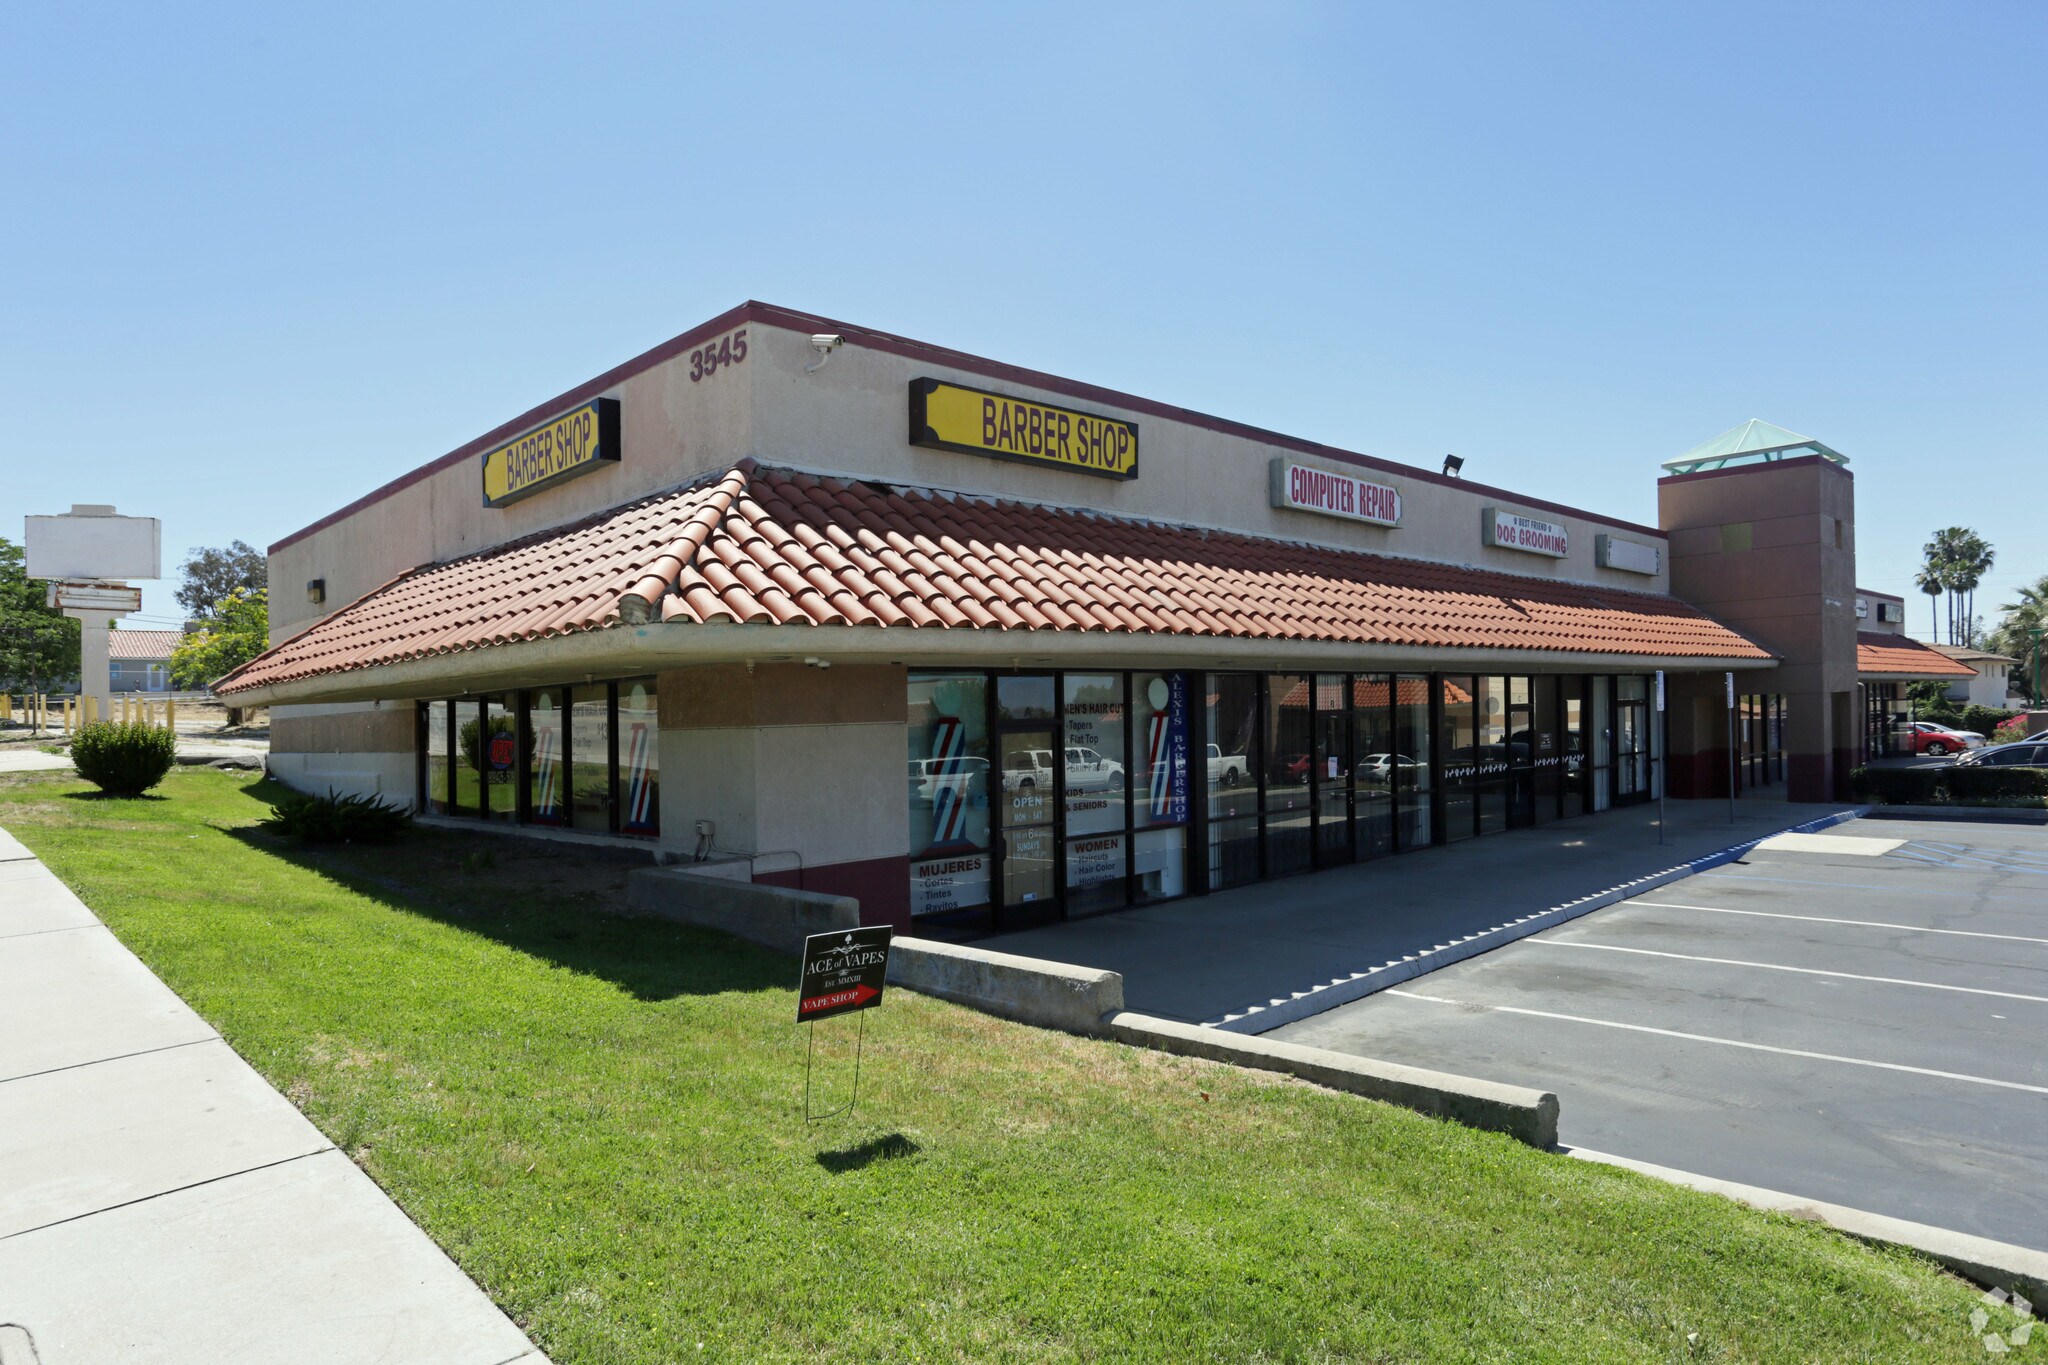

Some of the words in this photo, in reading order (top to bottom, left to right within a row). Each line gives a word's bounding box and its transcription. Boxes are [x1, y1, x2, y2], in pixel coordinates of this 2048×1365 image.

[690, 330, 748, 382] 3545
[983, 397, 1071, 460] BARBER
[1076, 418, 1129, 470] SHOP
[506, 429, 554, 491] BARBER
[556, 411, 591, 470] SHOP
[1291, 466, 1354, 513] COMPUTER
[1360, 483, 1395, 521] REPAIR
[1519, 518, 1530, 528] BEST
[1530, 520, 1548, 531] FRIEND
[1496, 523, 1516, 544] DOG
[1519, 528, 1567, 554] GROOMING
[1172, 673, 1183, 726] ALEXIS
[1089, 703, 1108, 715] HAIR
[1069, 720, 1093, 732] Tapers
[1070, 734, 1084, 744] Flat
[1085, 733, 1099, 745] Top
[1065, 788, 1084, 797] KIDS
[1013, 796, 1042, 808] OPEN
[1073, 801, 1108, 811] SENIORS
[1014, 812, 1026, 822] MON
[1033, 811, 1043, 820] SAT
[1016, 840, 1040, 852] SUNDAYS
[1074, 839, 1119, 853] WOMEN
[1078, 853, 1109, 864] Haircuts
[919, 858, 982, 878] MUJERES
[1078, 865, 1094, 875] Hair
[1095, 863, 1116, 873] Color
[925, 877, 954, 888] Cortes
[925, 889, 952, 900] Tintes
[806, 959, 833, 975] ACE
[845, 951, 885, 967] VAPES
[803, 998, 829, 1010] VAPE
[830, 992, 859, 1004] SHOP
